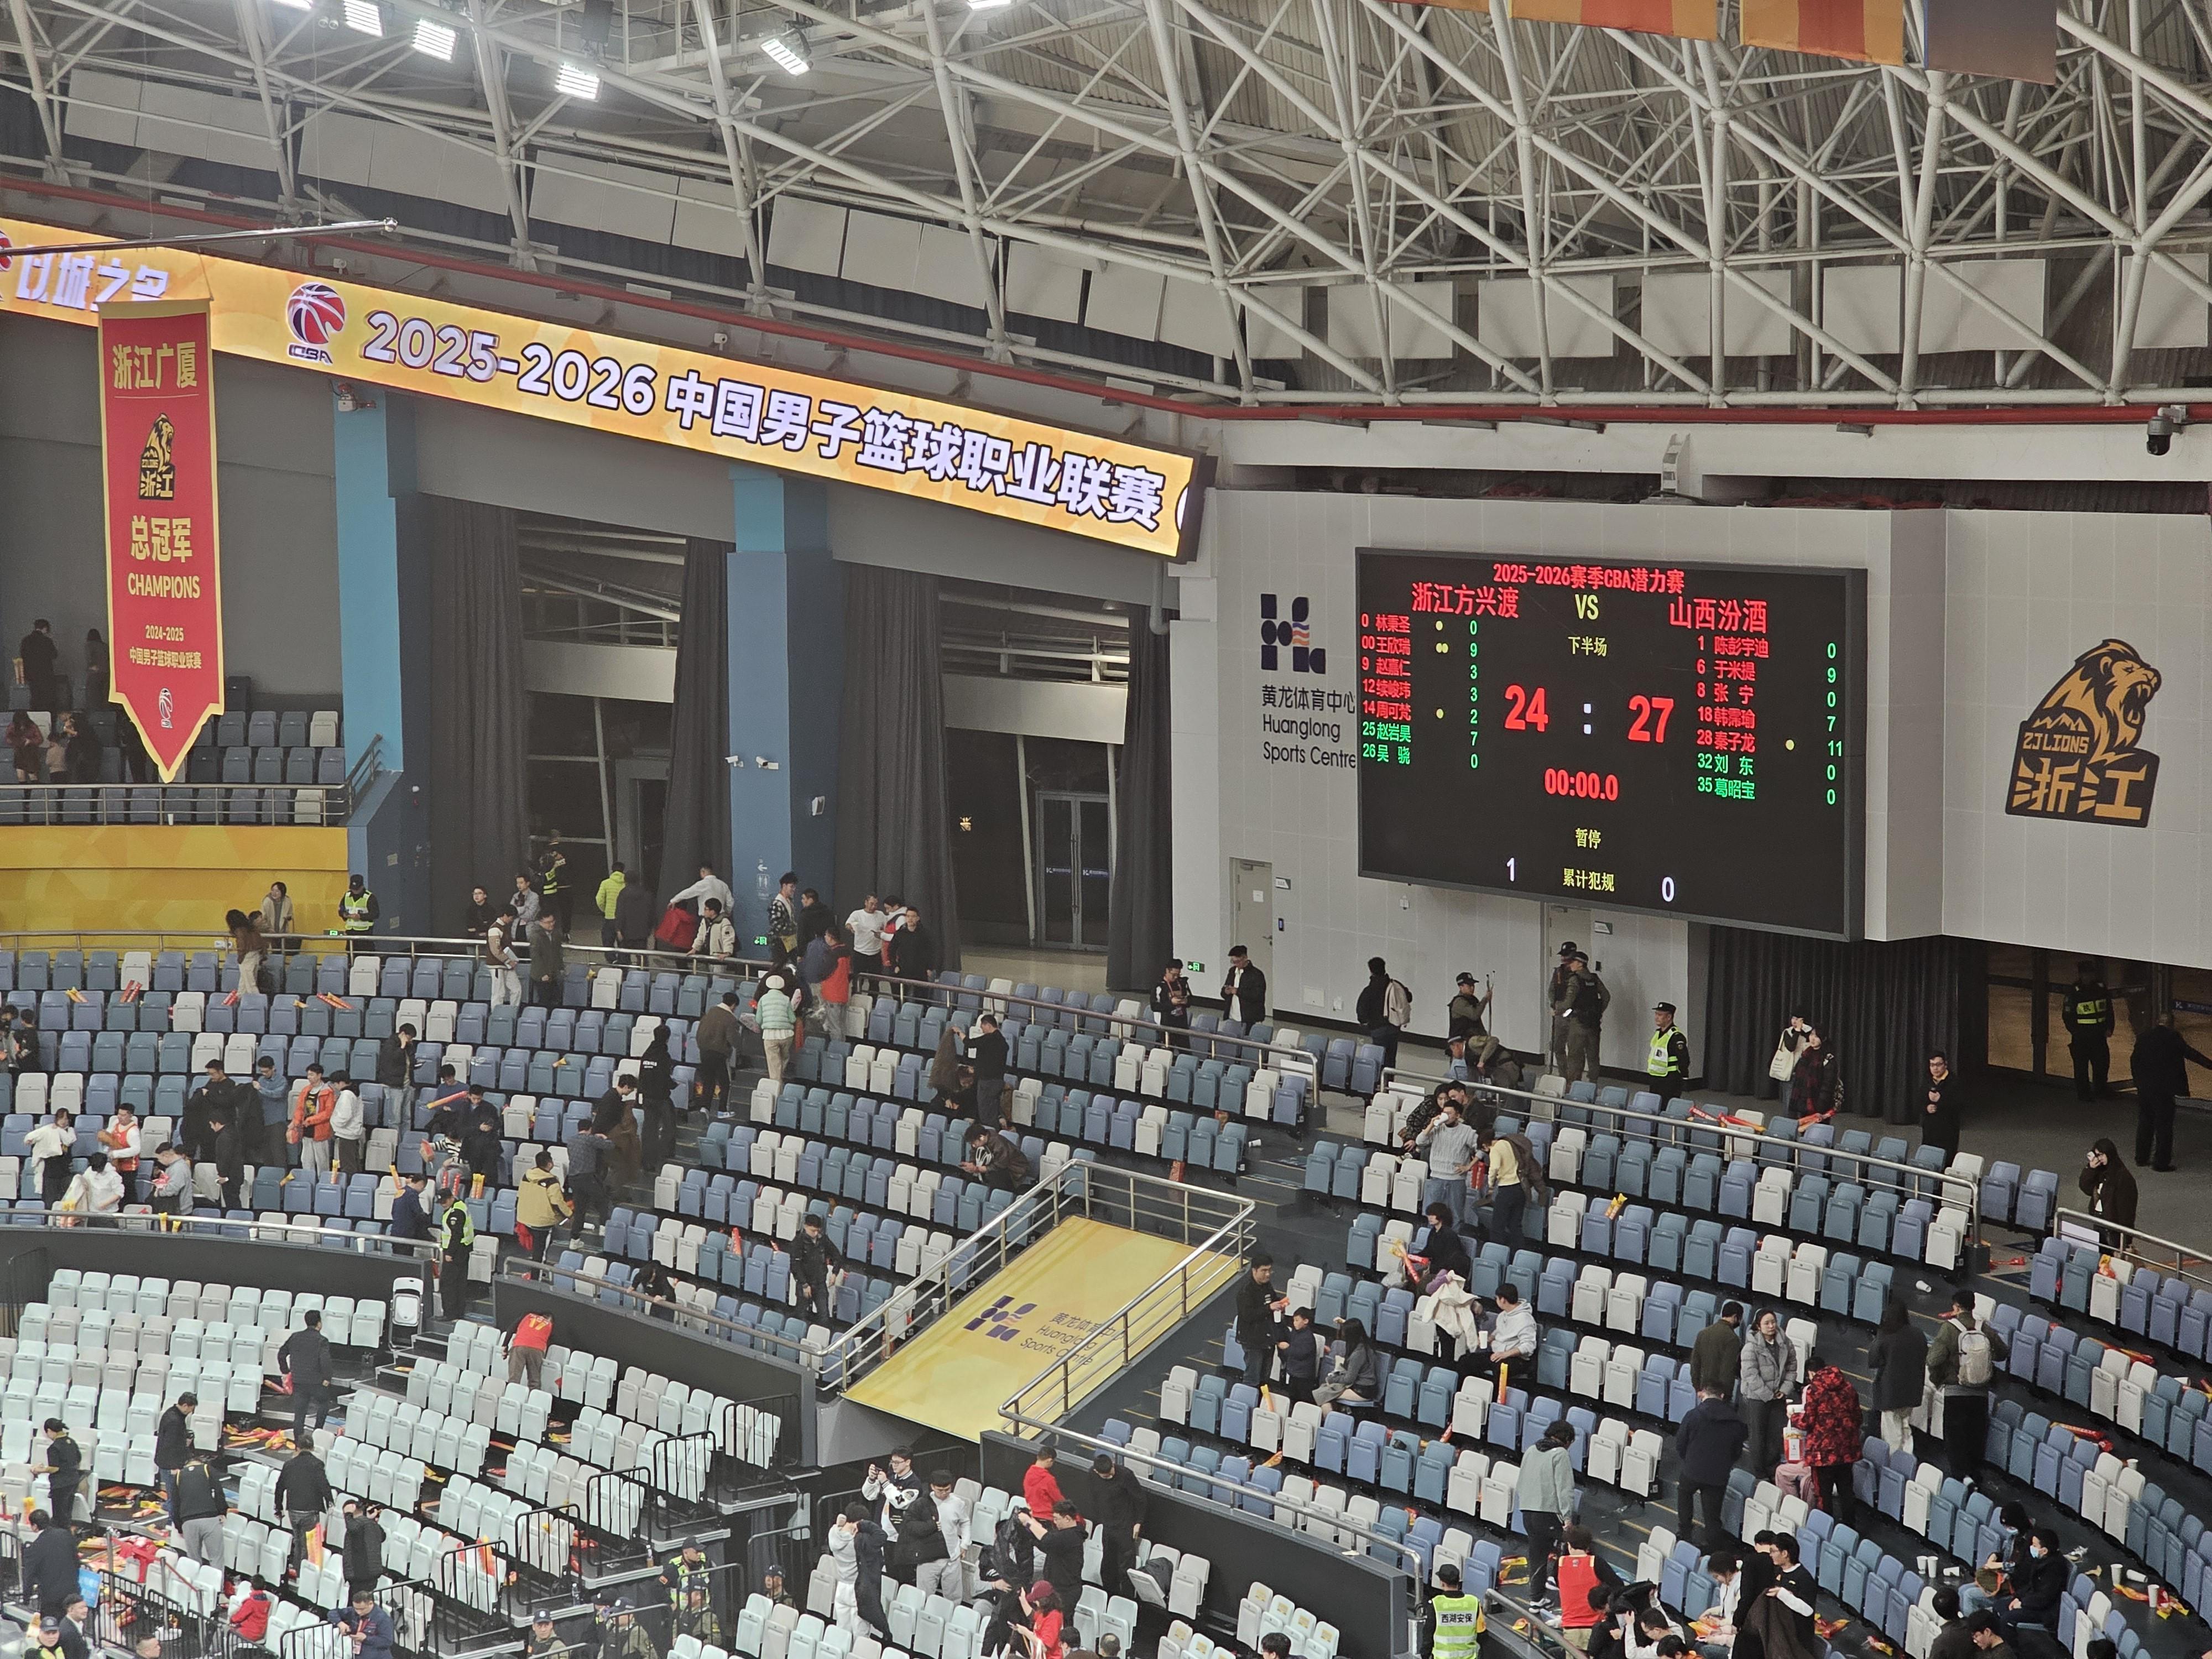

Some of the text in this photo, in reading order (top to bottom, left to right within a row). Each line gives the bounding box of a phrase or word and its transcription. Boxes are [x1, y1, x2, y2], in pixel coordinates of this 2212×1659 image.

[112, 341, 197, 389] 浙江广厦
[362, 310, 1166, 532] 2025-2026 中国男子篮球职业联赛
[140, 469, 174, 497] 浙江
[131, 515, 193, 563] 总冠军
[128, 573, 200, 599] CHAMPIONS
[1493, 564, 1685, 594] 2025-2026赛季CBA潜力赛
[1411, 582, 1519, 618] 浙江方兴渡
[1574, 594, 1599, 620] VS
[1361, 613, 1477, 635] 0 林秉圣 0
[1670, 596, 1767, 634] 山西汾酒
[145, 625, 184, 641] 2024-2025
[129, 646, 202, 669] 中国男子篮球职业联赛
[1361, 635, 1478, 658] 00 王欣瑞 9
[1568, 636, 1607, 657] 下半场
[1698, 635, 1704, 650] 1
[1827, 643, 1836, 659] 0
[1361, 656, 1478, 680] 9 赵嘉仁 3
[1697, 659, 1836, 683] 6 于米提 9
[1261, 684, 1355, 713] 黄龙体育中心
[1363, 679, 1376, 693] 12
[1470, 687, 1478, 702] 3
[1697, 682, 1705, 698] 8
[1827, 691, 1836, 707] 0
[1363, 700, 1478, 724] 14 周可梵 2
[1504, 685, 1549, 732] 24
[1627, 695, 1674, 743] 27
[1698, 706, 1713, 722] 18
[1827, 716, 1836, 732] 7
[1263, 714, 1340, 743] Huanglong
[1363, 721, 1478, 746] 25 赵岩昊 7
[1263, 741, 1357, 769] Sports Centre
[1363, 743, 1376, 758] 26
[1470, 754, 1478, 769] 0
[1697, 729, 1841, 757] 28 秦子龙 11
[1698, 753, 1713, 769] 32
[1827, 764, 1835, 780] 0
[1545, 768, 1619, 801] 00:00.0
[1698, 776, 1835, 805] 35 葛昭宝 0
[2012, 756, 2147, 820] 浙江
[1575, 828, 1601, 849] 暂停
[1506, 857, 1515, 881] 1
[1563, 868, 1615, 892] 累计犯规
[1662, 877, 1674, 902] 0
[1036, 1325, 1098, 1351] Huanglog
[1050, 1312, 1121, 1340] 黄龙体育中
[1020, 1338, 1056, 1354] Sports
[1441, 1613, 1472, 1623] 西湖安保
